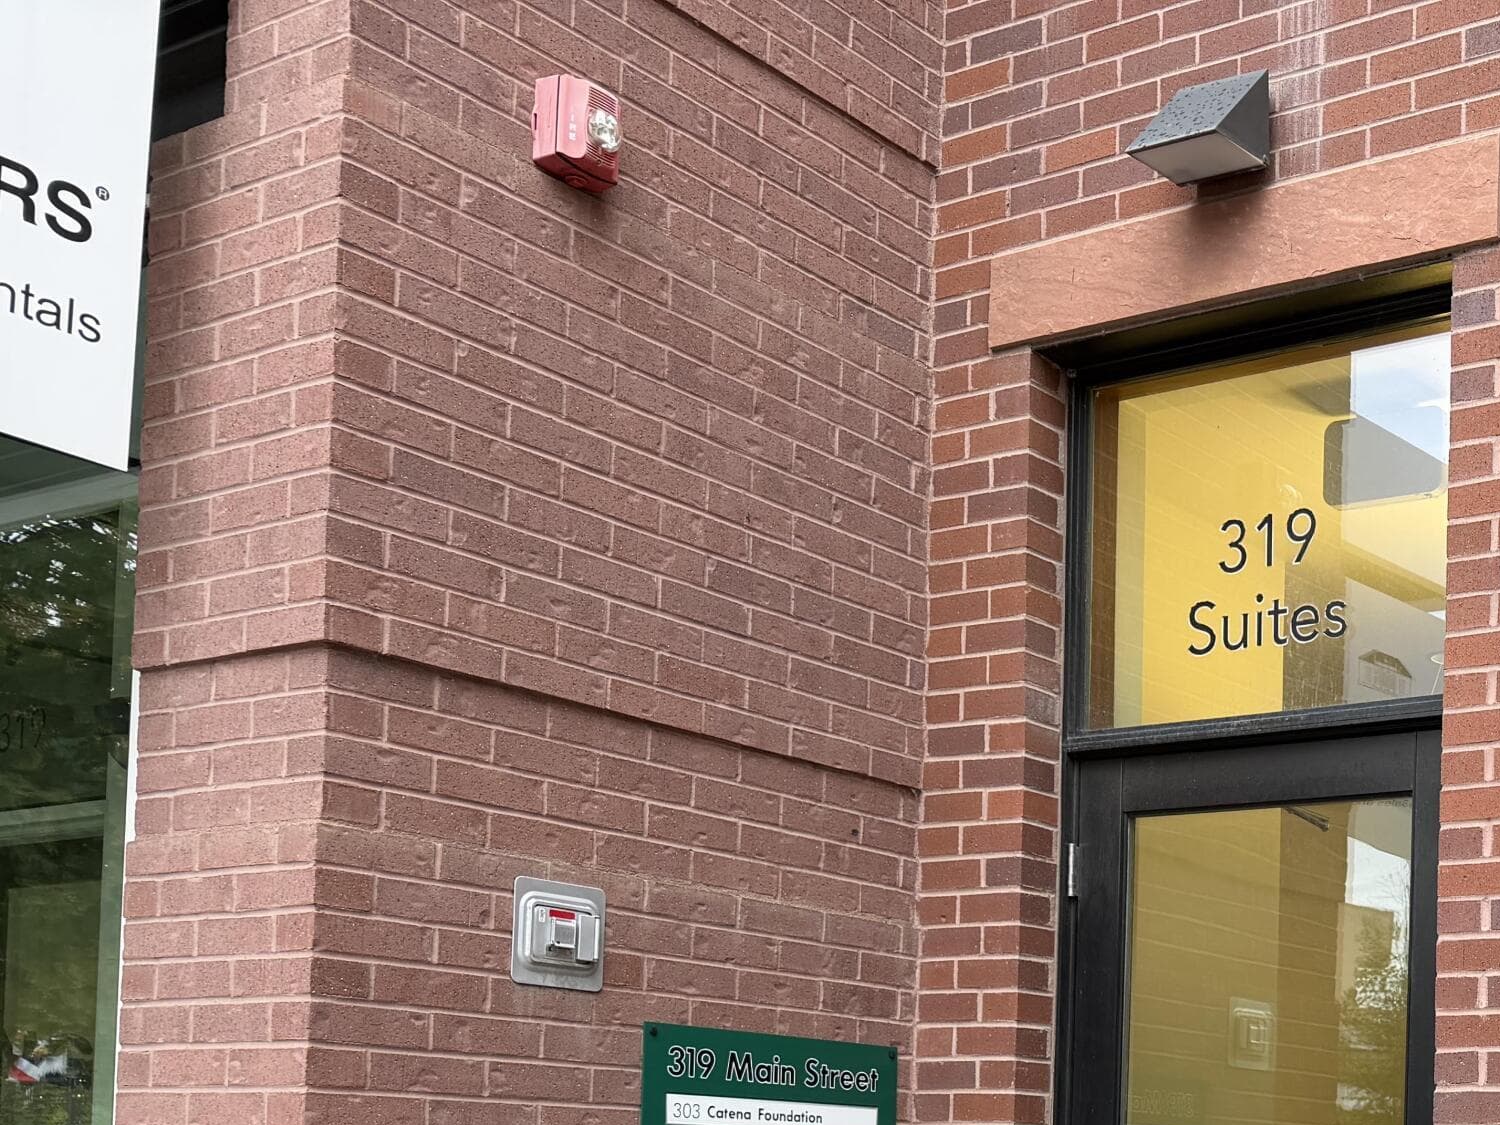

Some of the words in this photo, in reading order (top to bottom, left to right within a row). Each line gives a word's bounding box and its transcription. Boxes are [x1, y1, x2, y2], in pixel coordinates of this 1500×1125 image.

[1218, 508, 1317, 575] 319
[1187, 594, 1348, 657] Suites
[667, 1045, 716, 1080] 319
[726, 1050, 796, 1086] Main
[804, 1057, 879, 1092] Street
[672, 1102, 701, 1119] 303
[706, 1105, 752, 1121] Catena
[757, 1108, 823, 1124] Foundation
